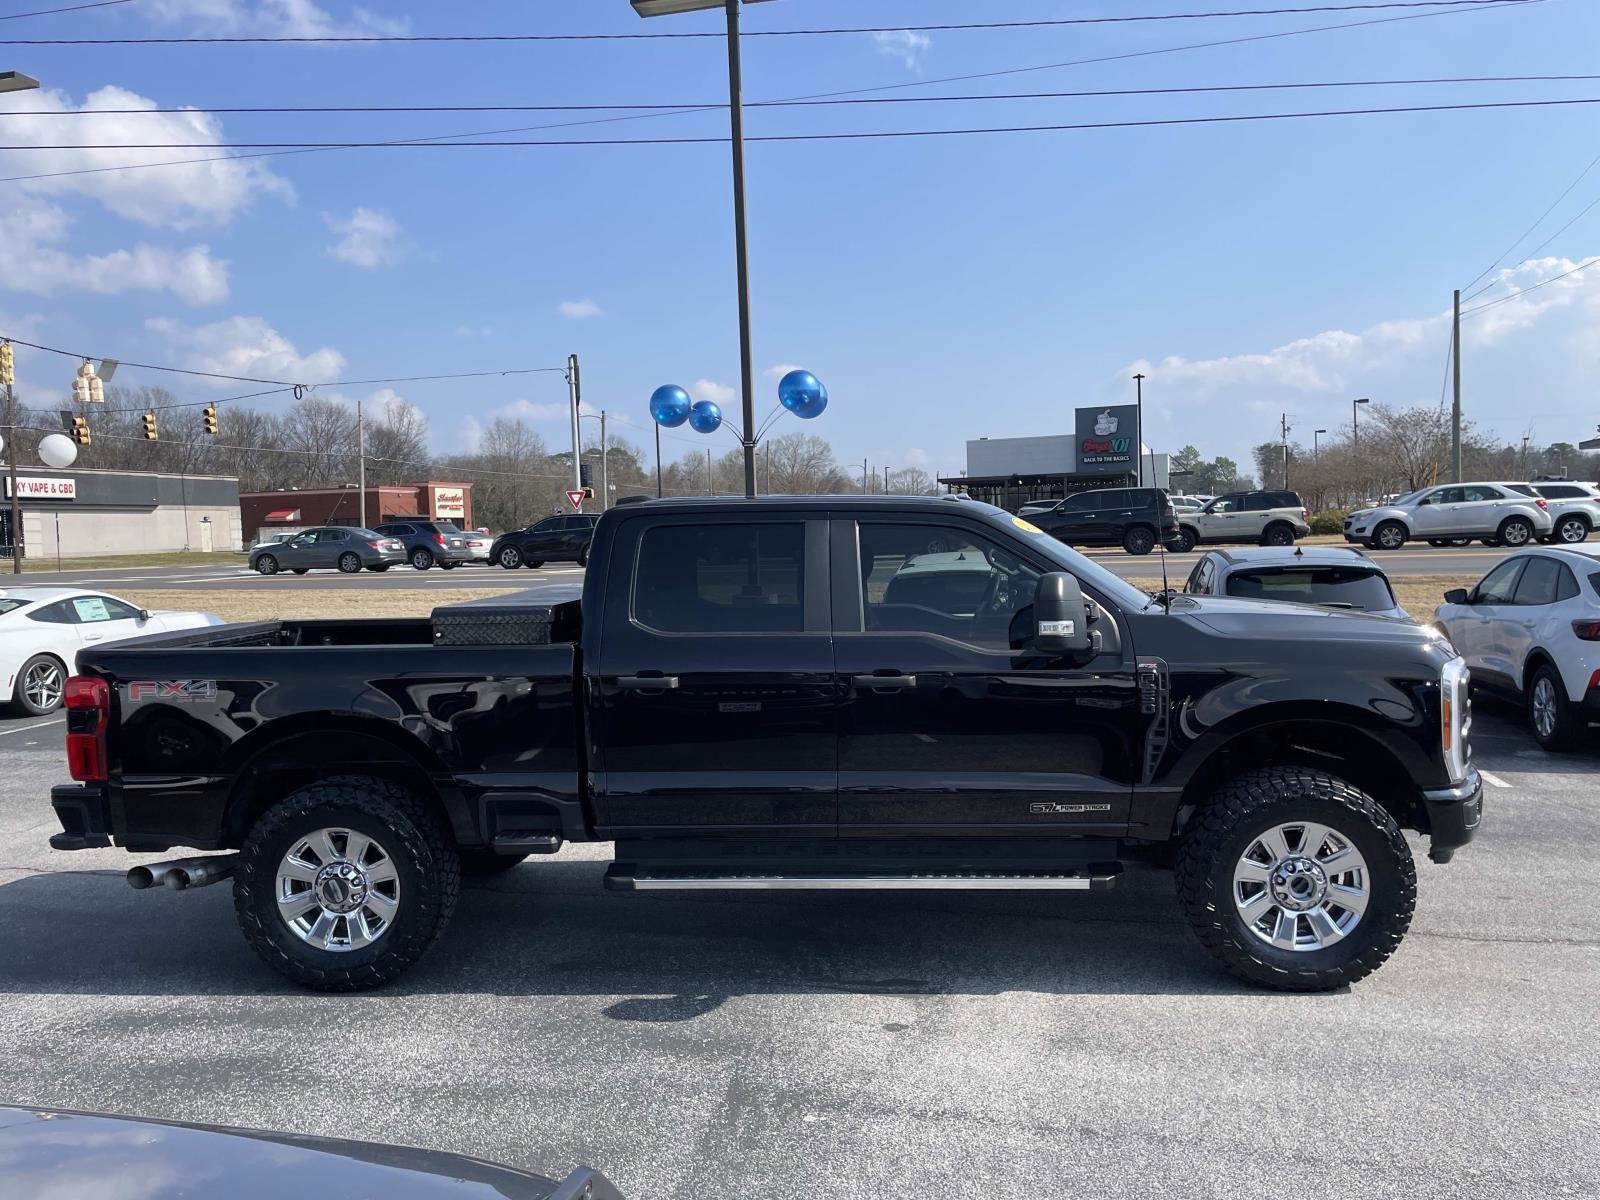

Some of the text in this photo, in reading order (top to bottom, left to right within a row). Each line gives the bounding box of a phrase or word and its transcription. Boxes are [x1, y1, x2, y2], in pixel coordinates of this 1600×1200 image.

[28, 482, 49, 493] VAPE
[51, 483, 57, 493] &
[58, 483, 74, 494] CBD
[127, 680, 217, 703] FX4
